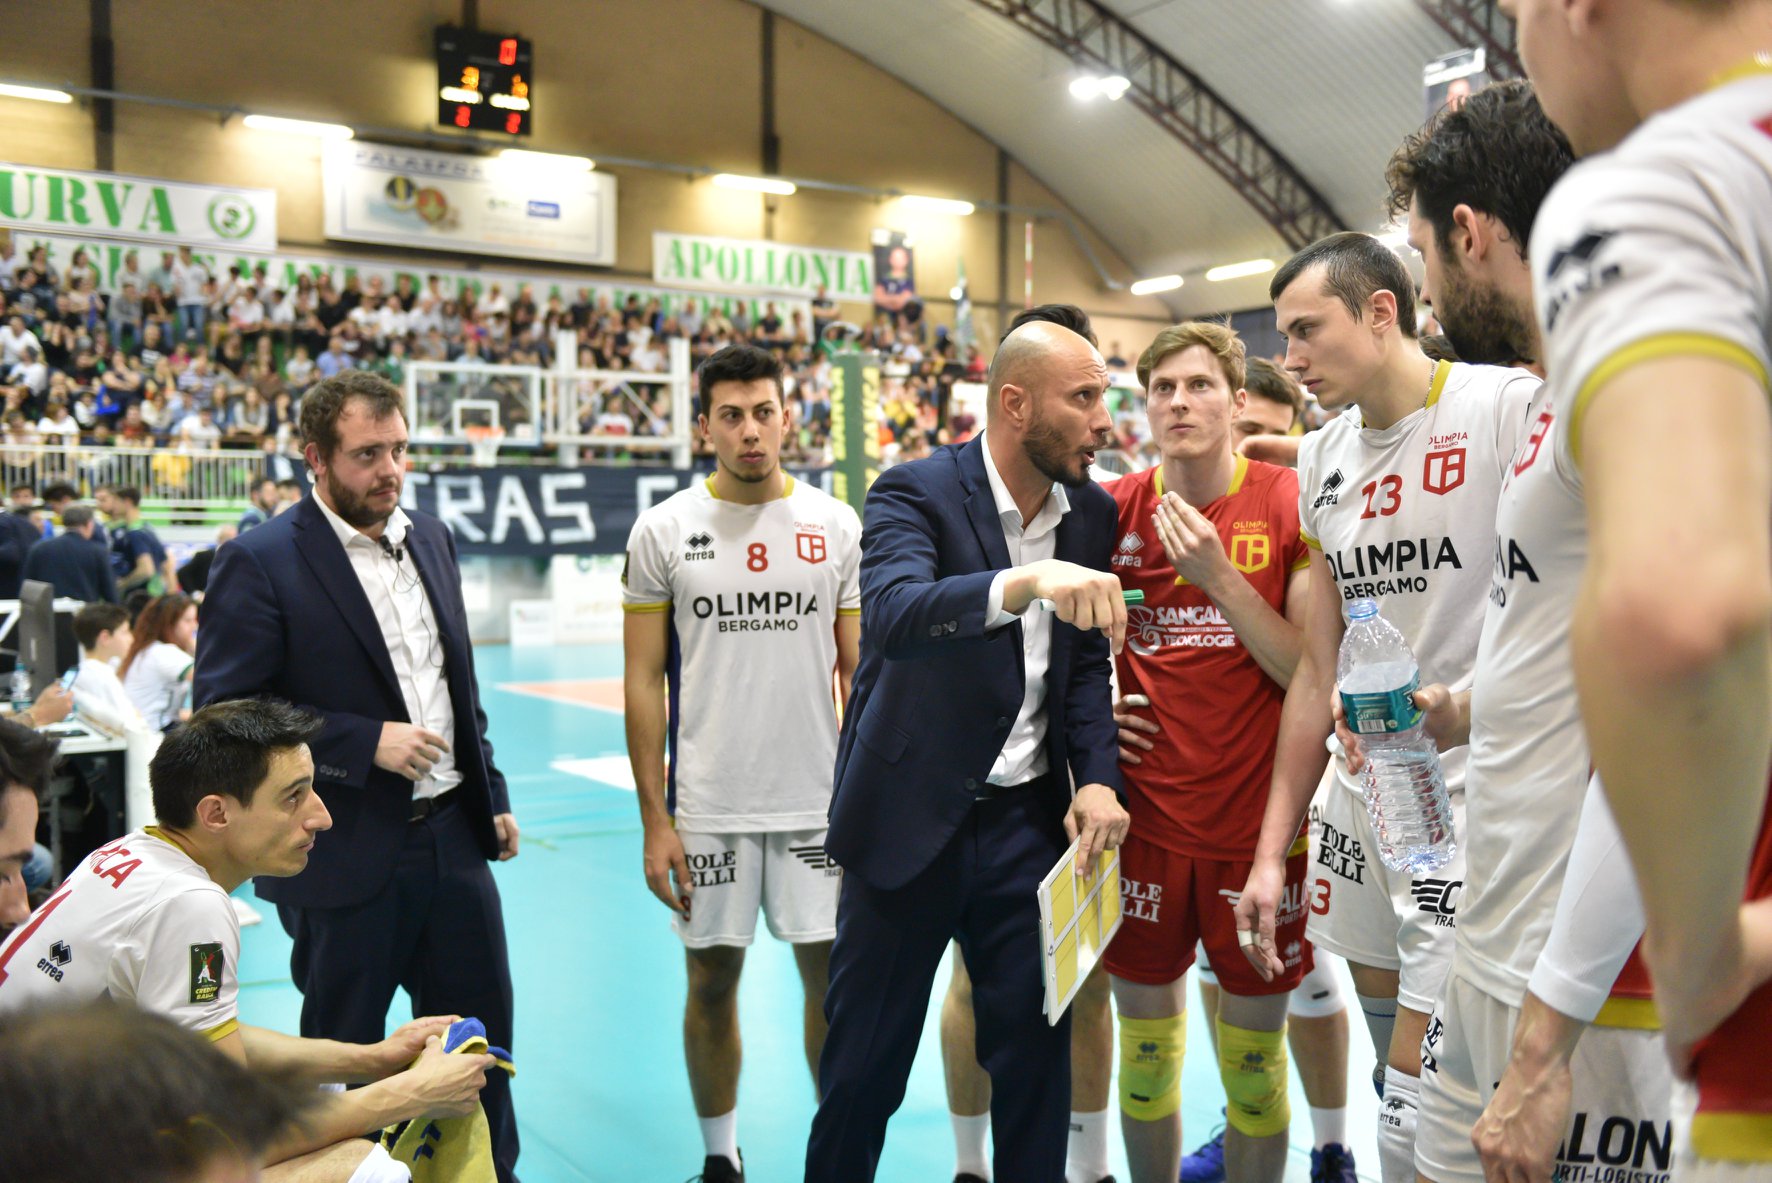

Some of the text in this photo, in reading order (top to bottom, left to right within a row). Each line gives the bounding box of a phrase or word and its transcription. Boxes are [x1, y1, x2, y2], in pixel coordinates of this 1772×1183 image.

[0, 170, 177, 234] URVA
[663, 239, 873, 295] APOLLONIA
[1360, 474, 1403, 520] 13
[794, 521, 825, 531] OLIMPIA
[1232, 520, 1268, 530] OLIMPIA
[685, 549, 715, 562] errea
[746, 542, 769, 573] 8
[1343, 576, 1428, 600] BERGAMO
[692, 591, 818, 619] OLIMPIA
[718, 619, 799, 633] BERGAMO
[1163, 633, 1236, 648] TECNOLOGIE
[37, 957, 64, 983] errea
[1556, 1112, 1673, 1171] LON
